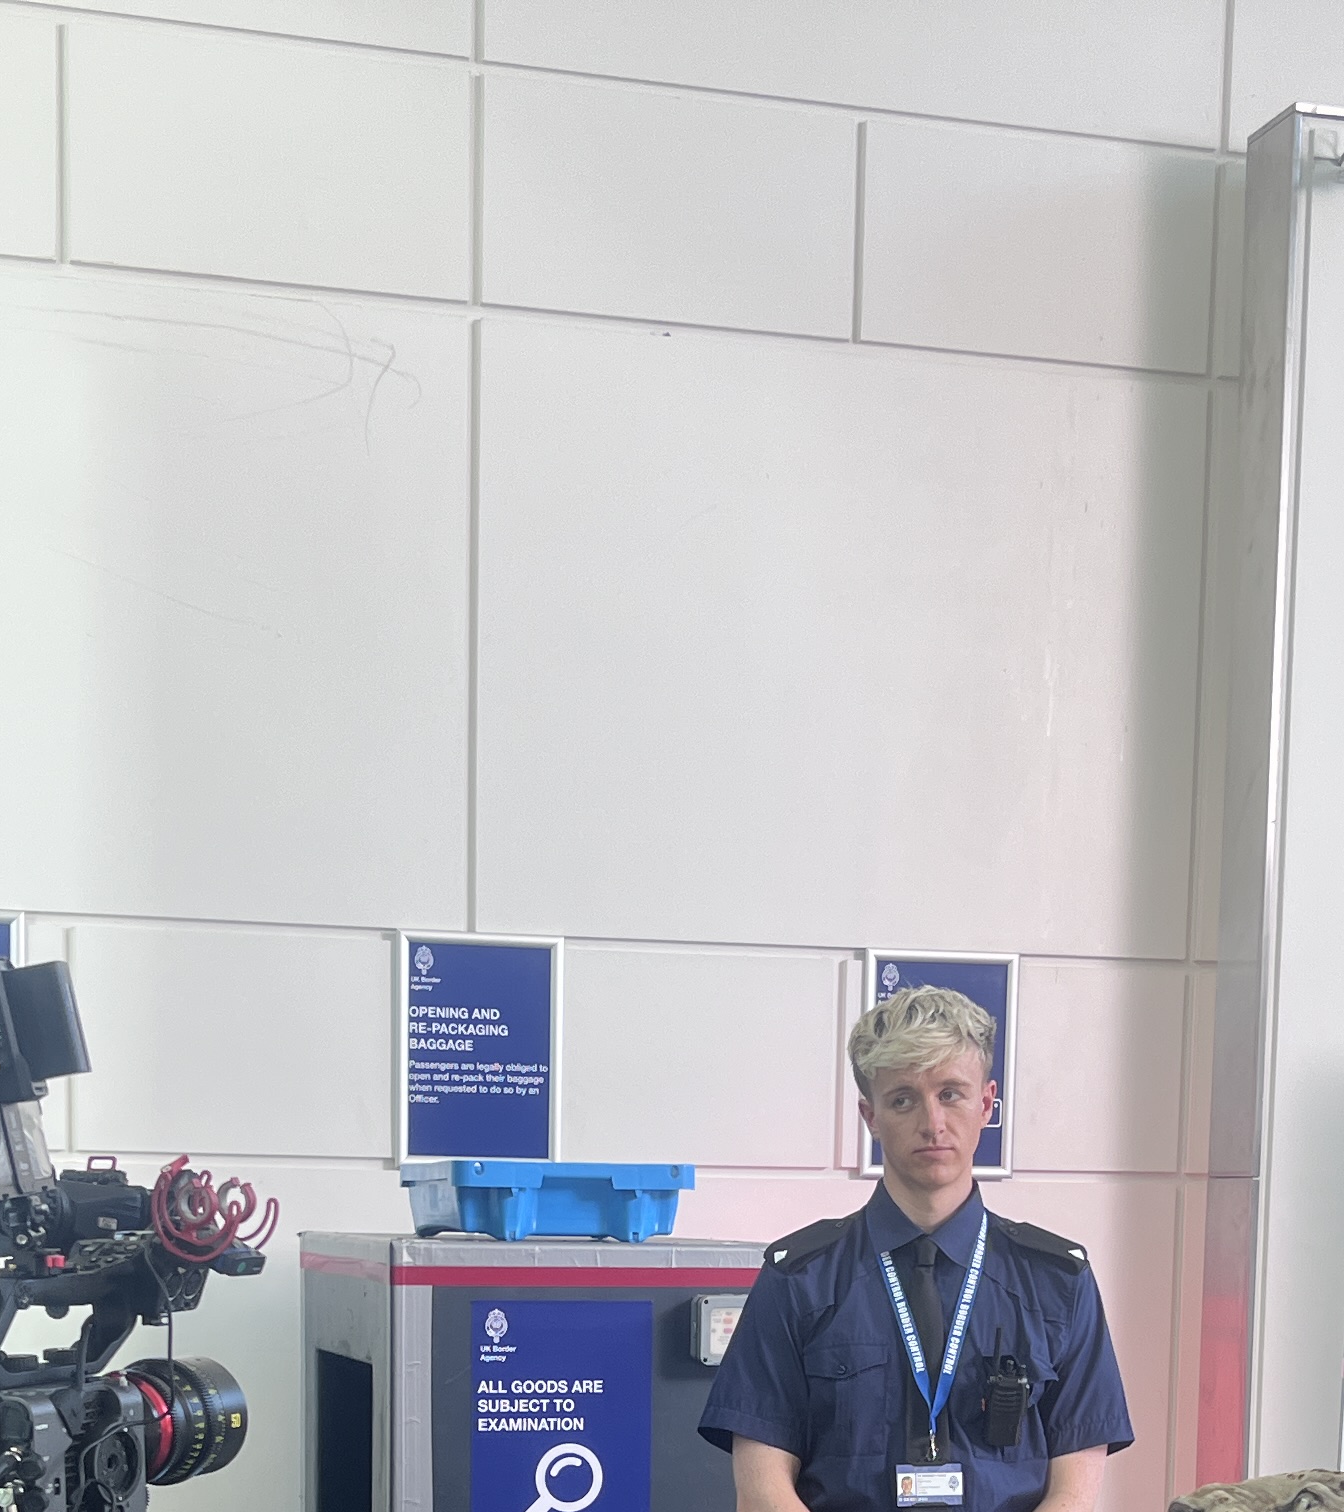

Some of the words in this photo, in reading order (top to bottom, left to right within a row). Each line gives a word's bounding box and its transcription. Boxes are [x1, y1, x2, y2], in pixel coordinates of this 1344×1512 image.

[409, 1006, 469, 1019] OPENING
[472, 1008, 500, 1020] AND
[409, 1022, 509, 1037] RE-PACKAGING
[409, 1038, 474, 1051] BAGGAGE
[408, 1060, 459, 1072] Passengers
[460, 1062, 475, 1071] are
[476, 1062, 504, 1074] legally
[506, 1063, 537, 1074] obliged
[539, 1064, 548, 1073] to
[408, 1073, 431, 1082] open
[432, 1072, 449, 1082] and
[451, 1073, 484, 1083] re-pack
[485, 1074, 506, 1083] their
[507, 1075, 544, 1085] baggage
[408, 1083, 432, 1092] when
[434, 1084, 477, 1095] requested
[479, 1085, 488, 1094] to
[490, 1085, 502, 1094] do
[503, 1087, 514, 1095] so
[516, 1086, 527, 1096] by
[408, 1094, 440, 1104] Officer.
[962, 1268, 980, 1303] CONTROL
[885, 1266, 905, 1302] CONTROL
[896, 1301, 914, 1335] BORDER
[906, 1334, 926, 1374] CONTROL
[952, 1303, 970, 1337] BORDER
[480, 1345, 491, 1353] UK
[493, 1345, 517, 1353] Border
[480, 1354, 506, 1362] Agency
[943, 1337, 960, 1375] CONTROL
[477, 1380, 507, 1394] ALL
[511, 1380, 568, 1394] GOODS
[571, 1380, 604, 1393] ARE
[477, 1399, 549, 1412] SUBJECT
[552, 1399, 575, 1412] TO
[477, 1418, 584, 1431] EXAMINATION
